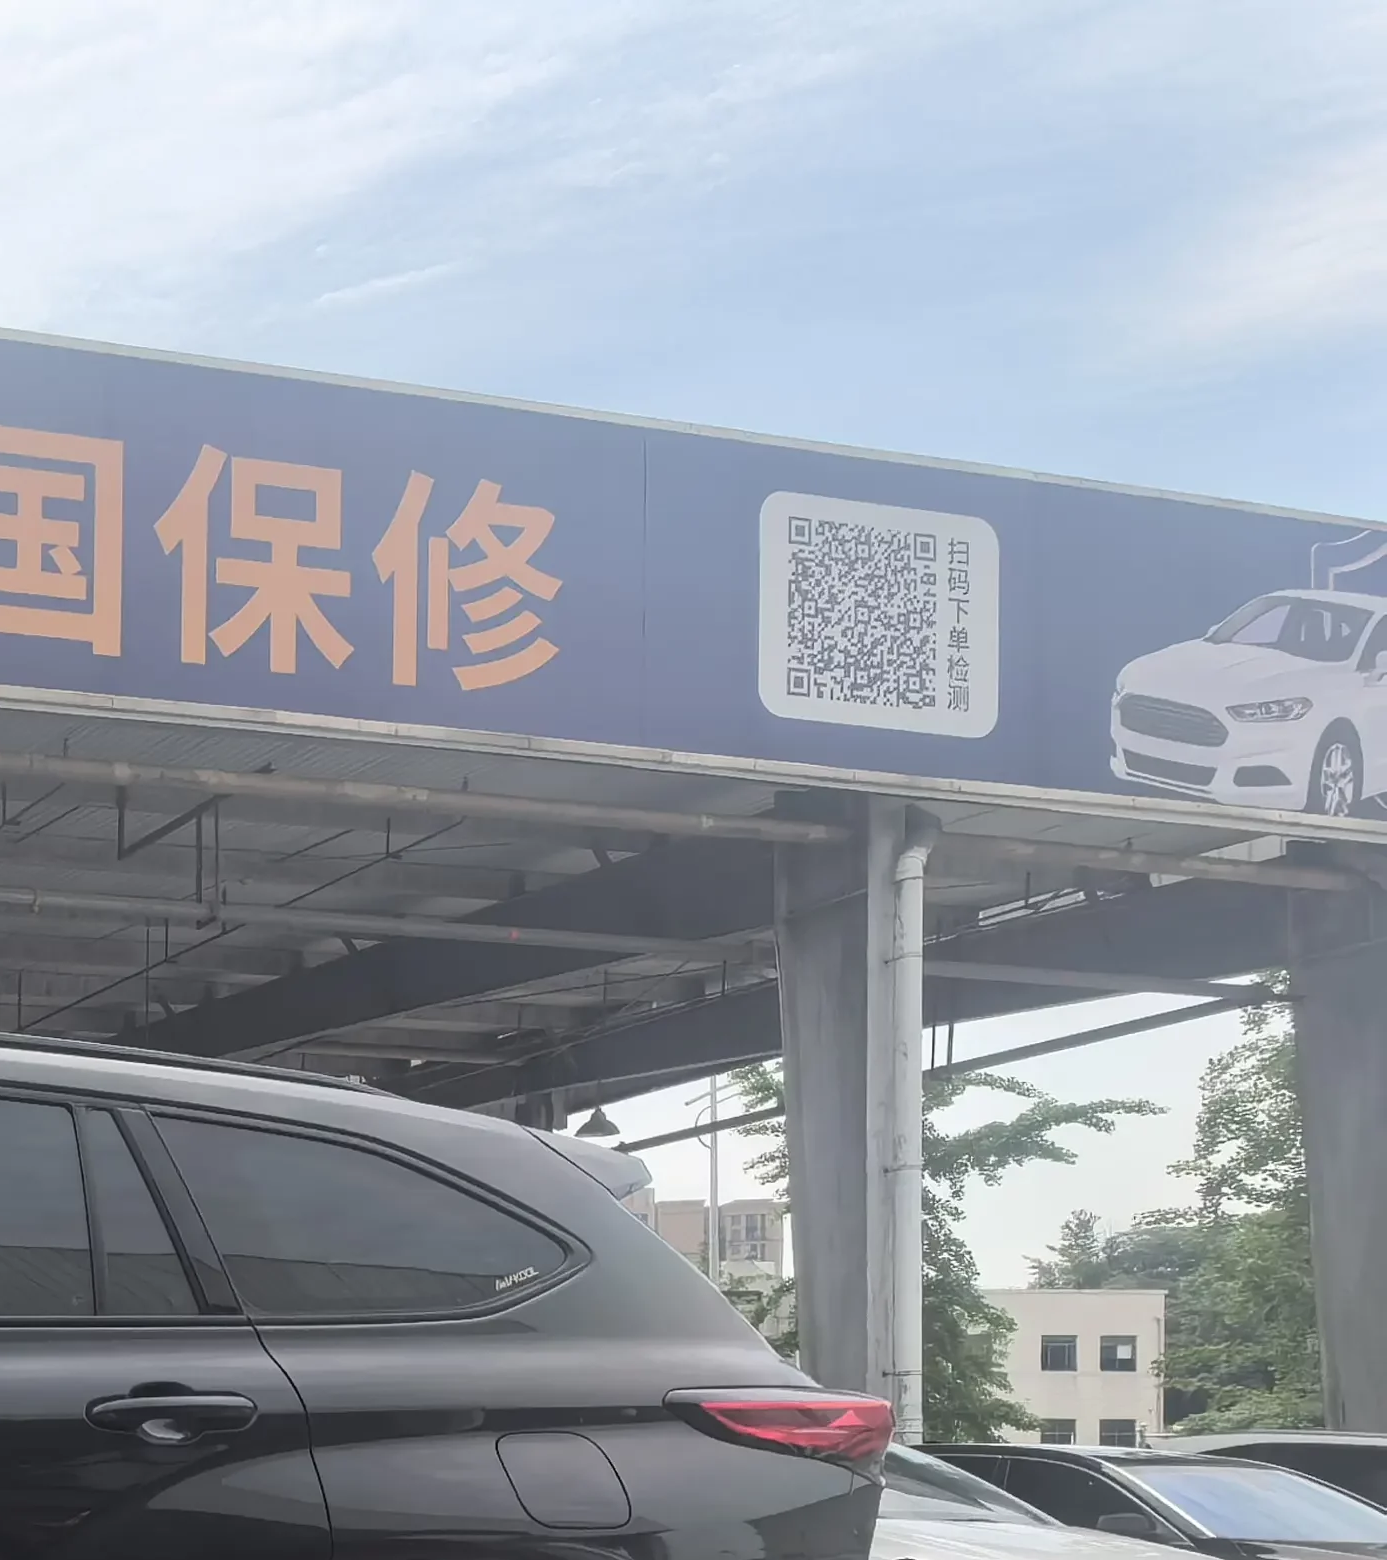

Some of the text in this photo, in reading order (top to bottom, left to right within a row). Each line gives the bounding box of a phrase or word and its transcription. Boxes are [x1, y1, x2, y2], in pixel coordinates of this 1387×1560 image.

[946, 536, 971, 713] 扫码下单检测
